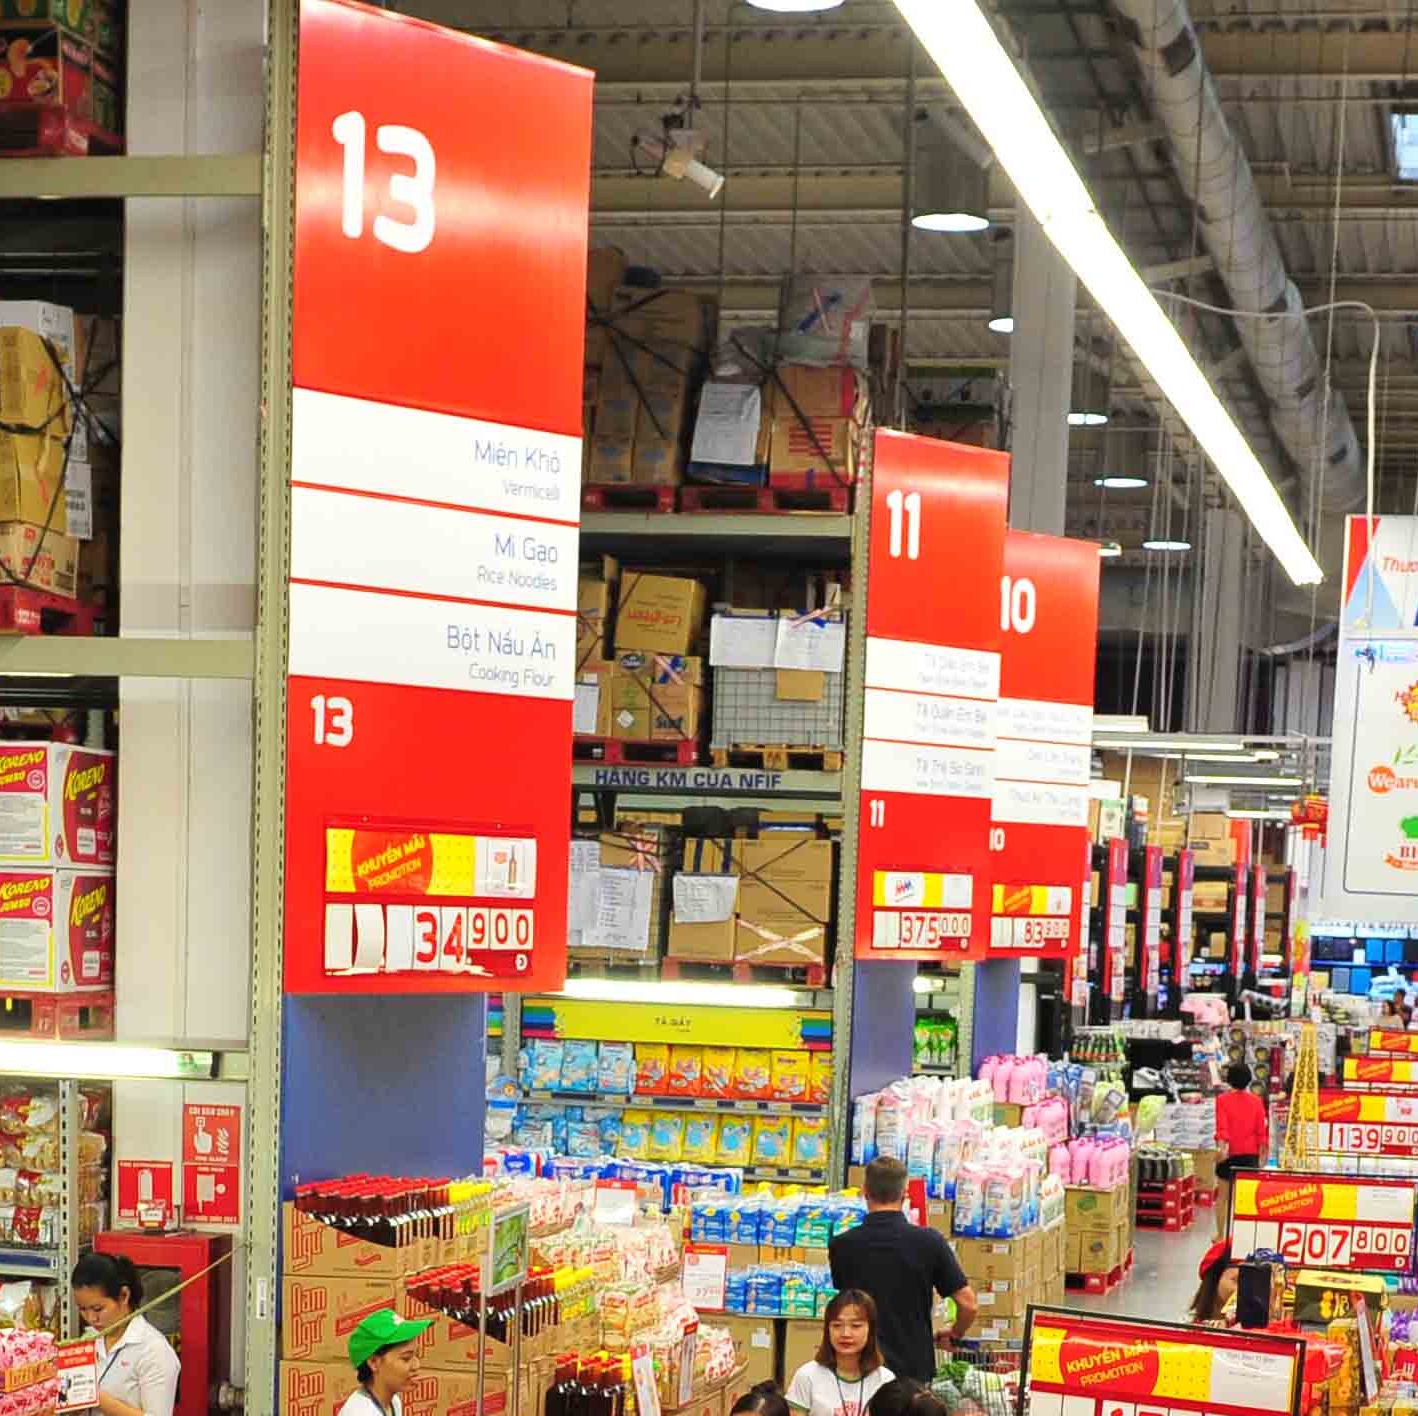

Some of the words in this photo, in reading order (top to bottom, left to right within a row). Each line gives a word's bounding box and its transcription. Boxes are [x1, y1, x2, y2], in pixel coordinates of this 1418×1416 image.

[332, 110, 437, 254] 13
[886, 489, 921, 560] 11
[1001, 575, 1036, 633] 10
[309, 693, 354, 748] 13
[869, 799, 885, 828] 11
[1080, 1360, 1144, 1387] PROMOTION
